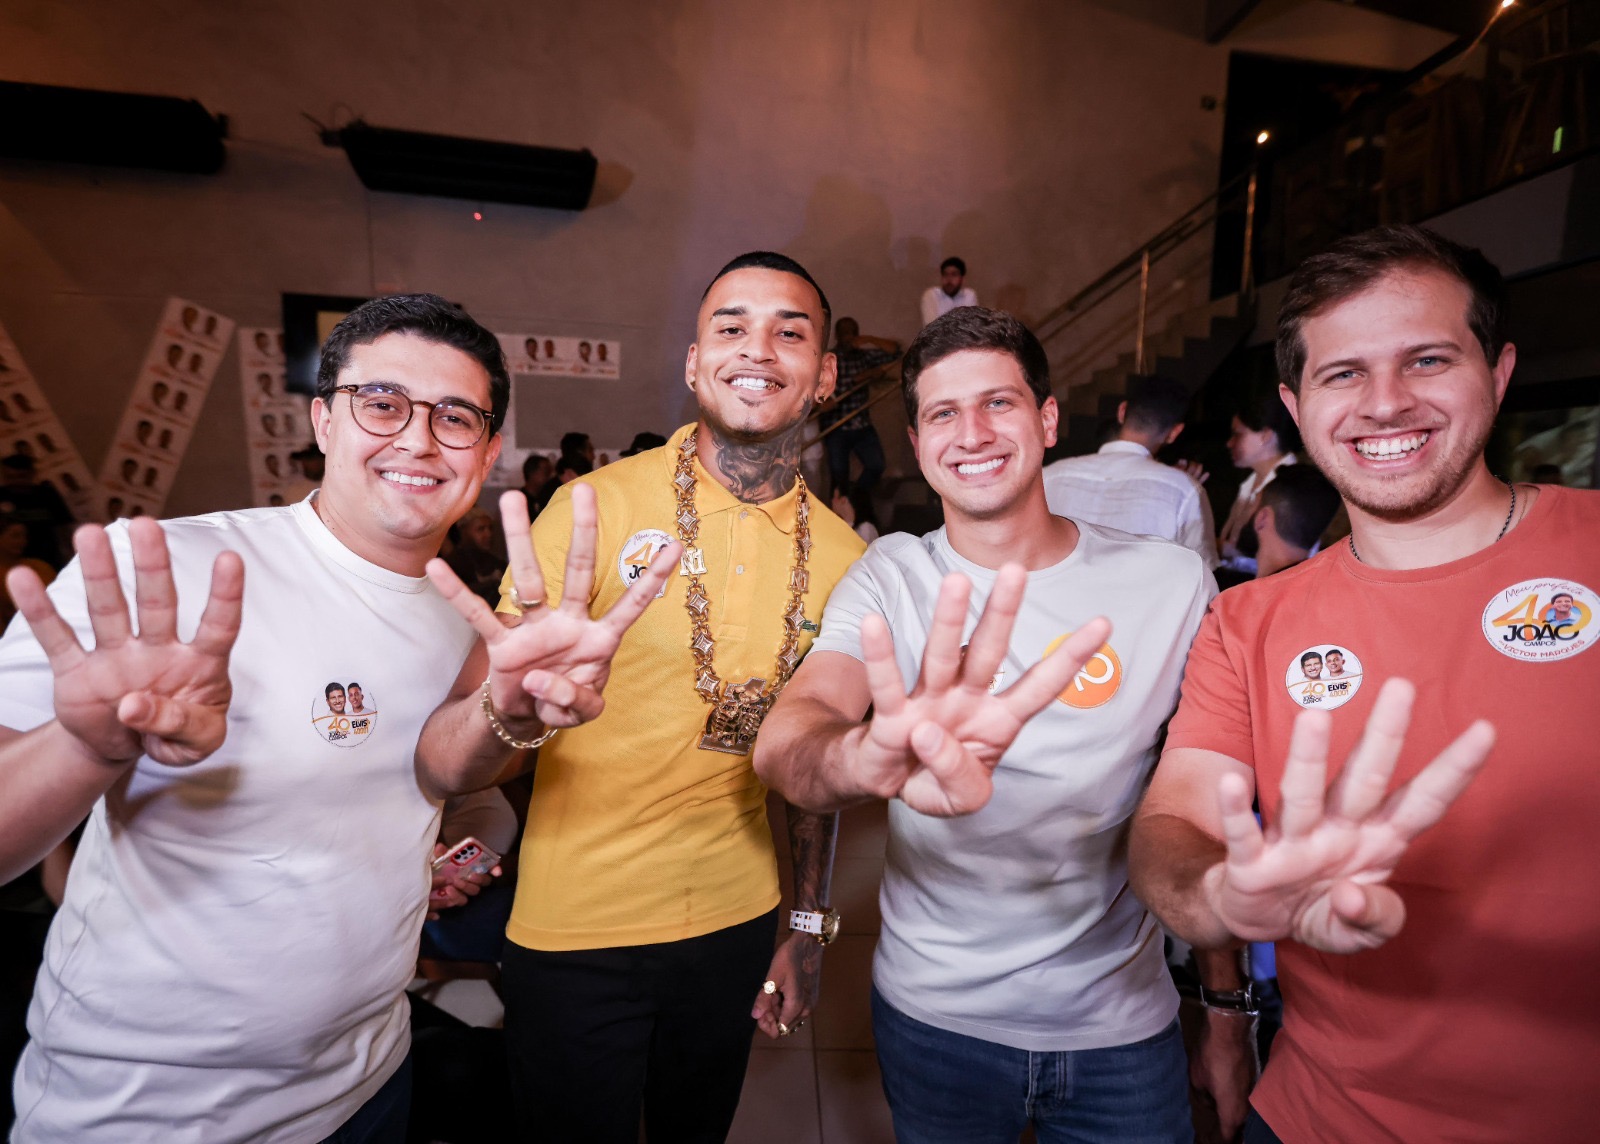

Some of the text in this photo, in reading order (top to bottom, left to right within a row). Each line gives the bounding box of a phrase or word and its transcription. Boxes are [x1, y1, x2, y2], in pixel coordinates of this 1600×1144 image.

[1492, 594, 1592, 640] 40
[1503, 643, 1537, 658] VICTOR
[328, 716, 368, 732] 40 ELVIS
